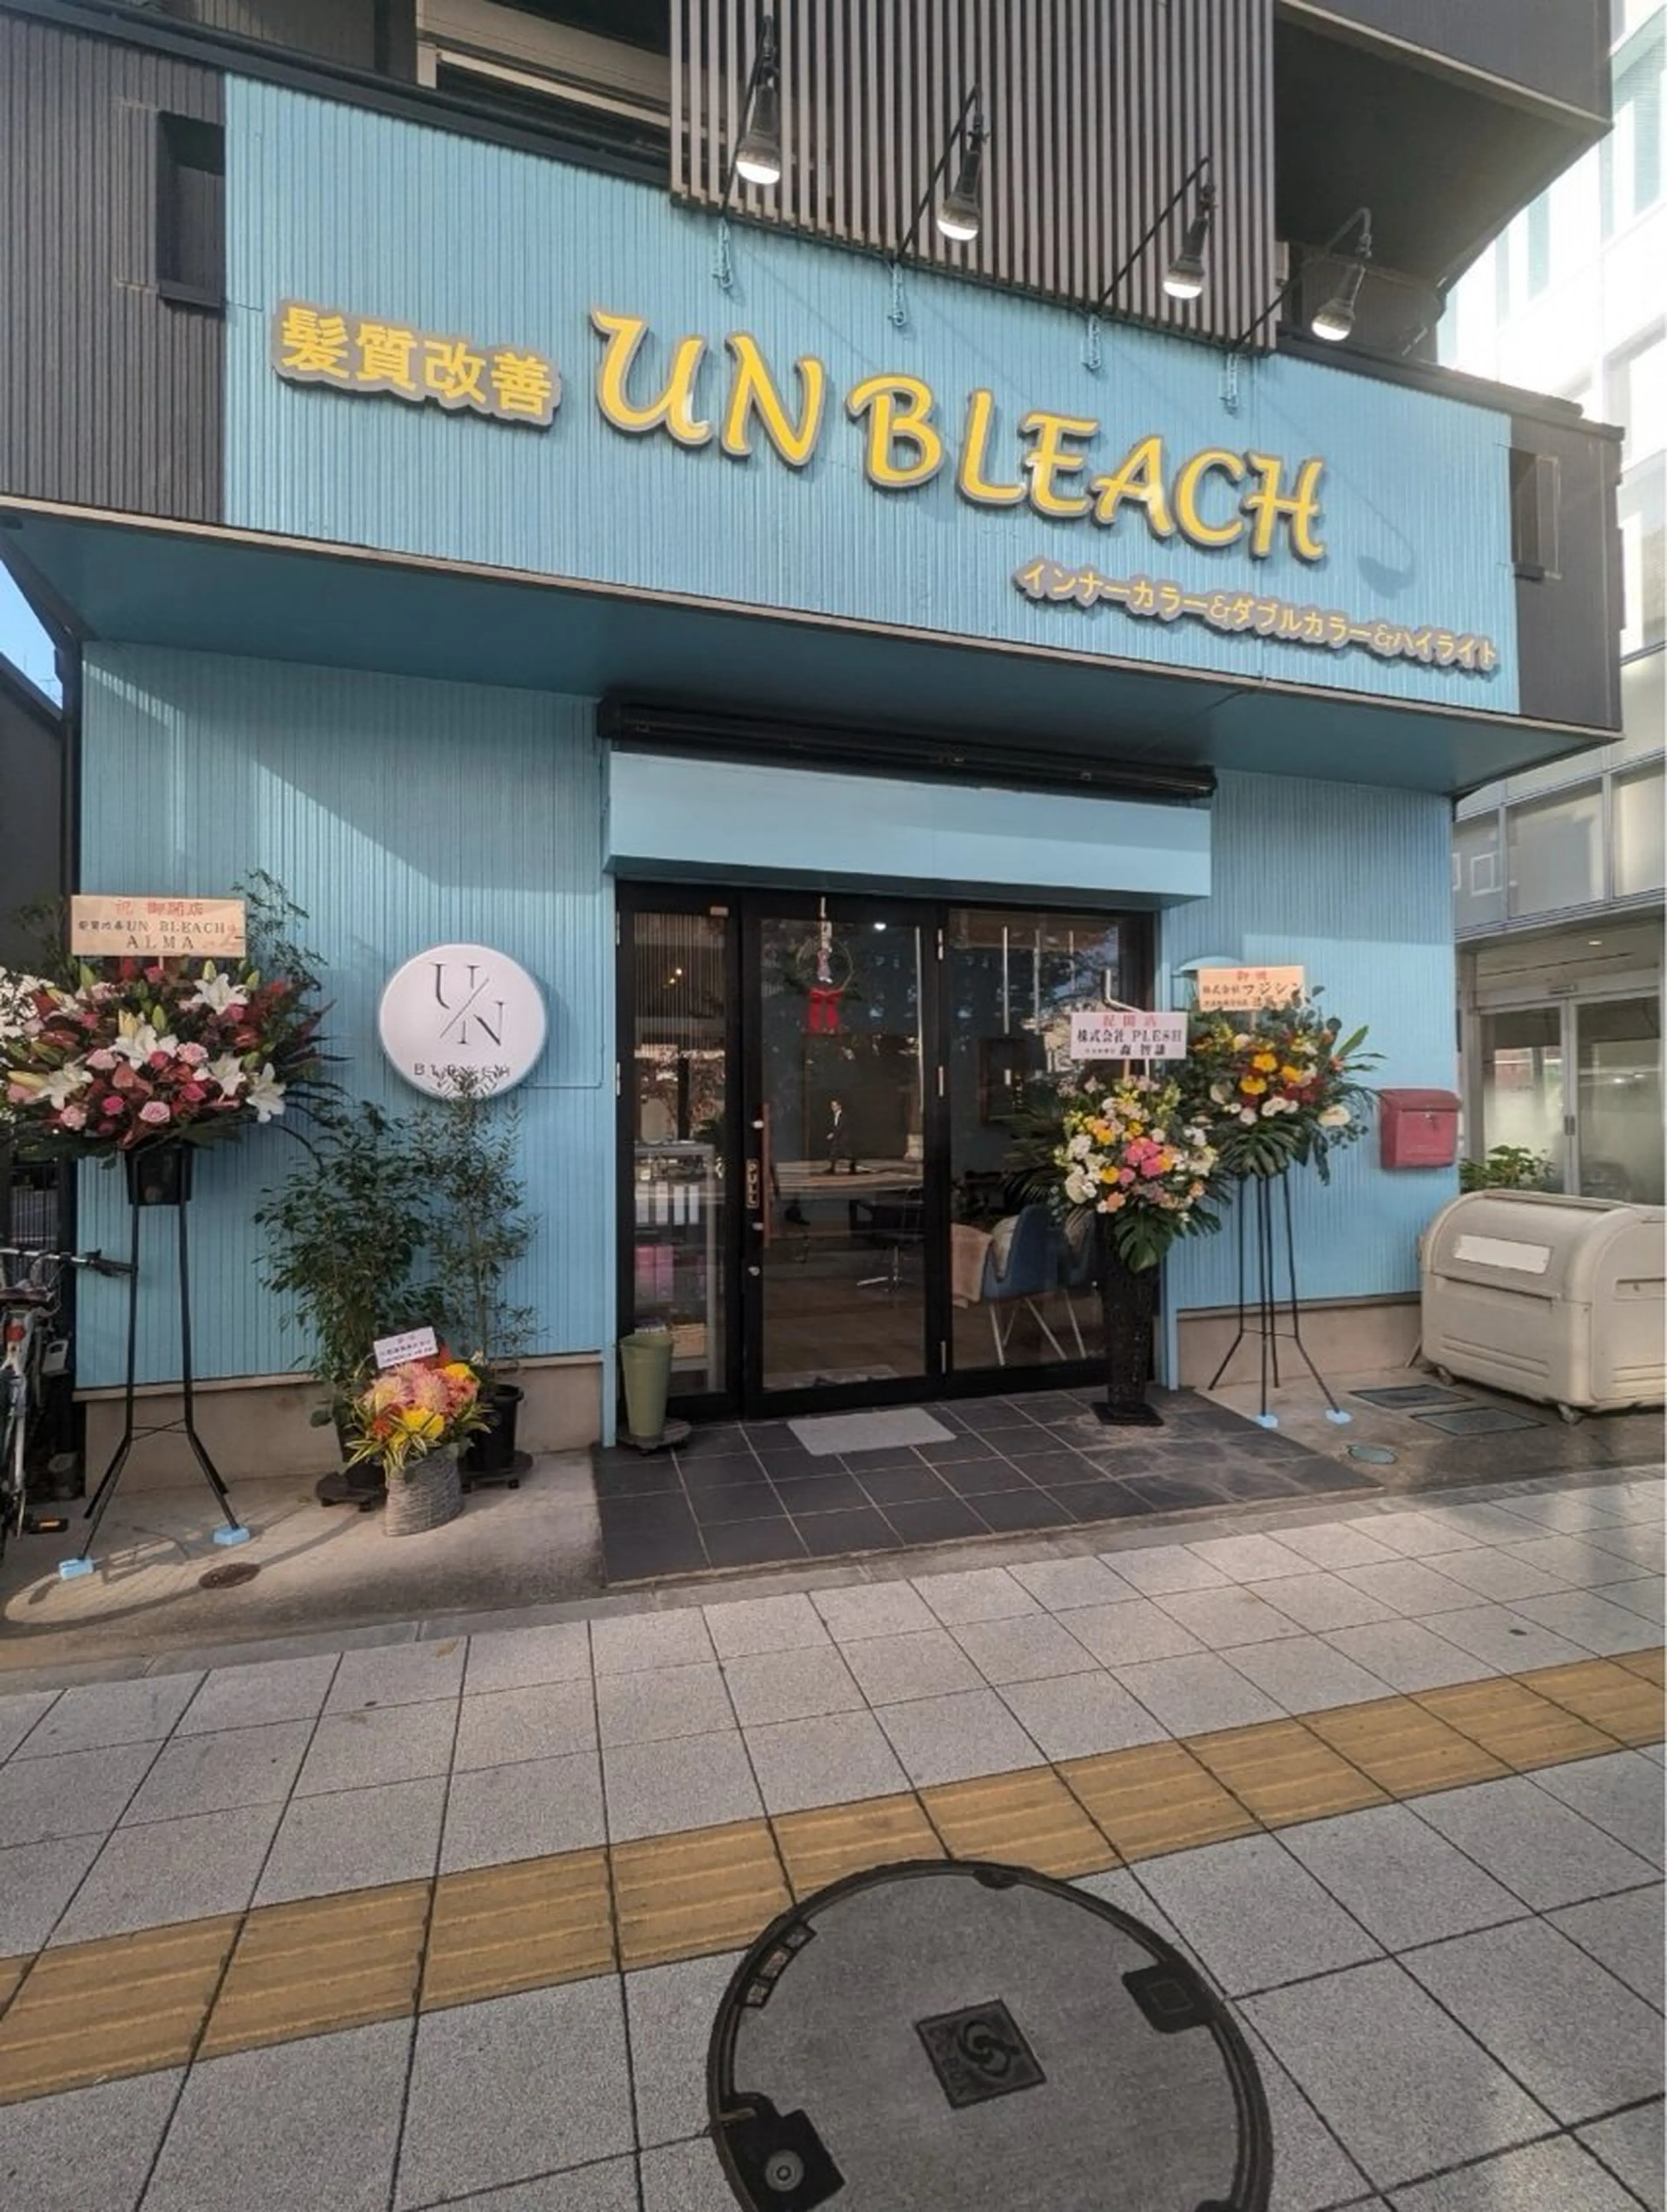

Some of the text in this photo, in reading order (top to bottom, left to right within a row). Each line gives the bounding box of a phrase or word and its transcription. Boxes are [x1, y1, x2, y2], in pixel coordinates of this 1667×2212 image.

[280, 305, 554, 418] 髪質改善
[592, 310, 1325, 560] UN BLEACH
[1077, 1029, 1124, 1043] 株式会社
